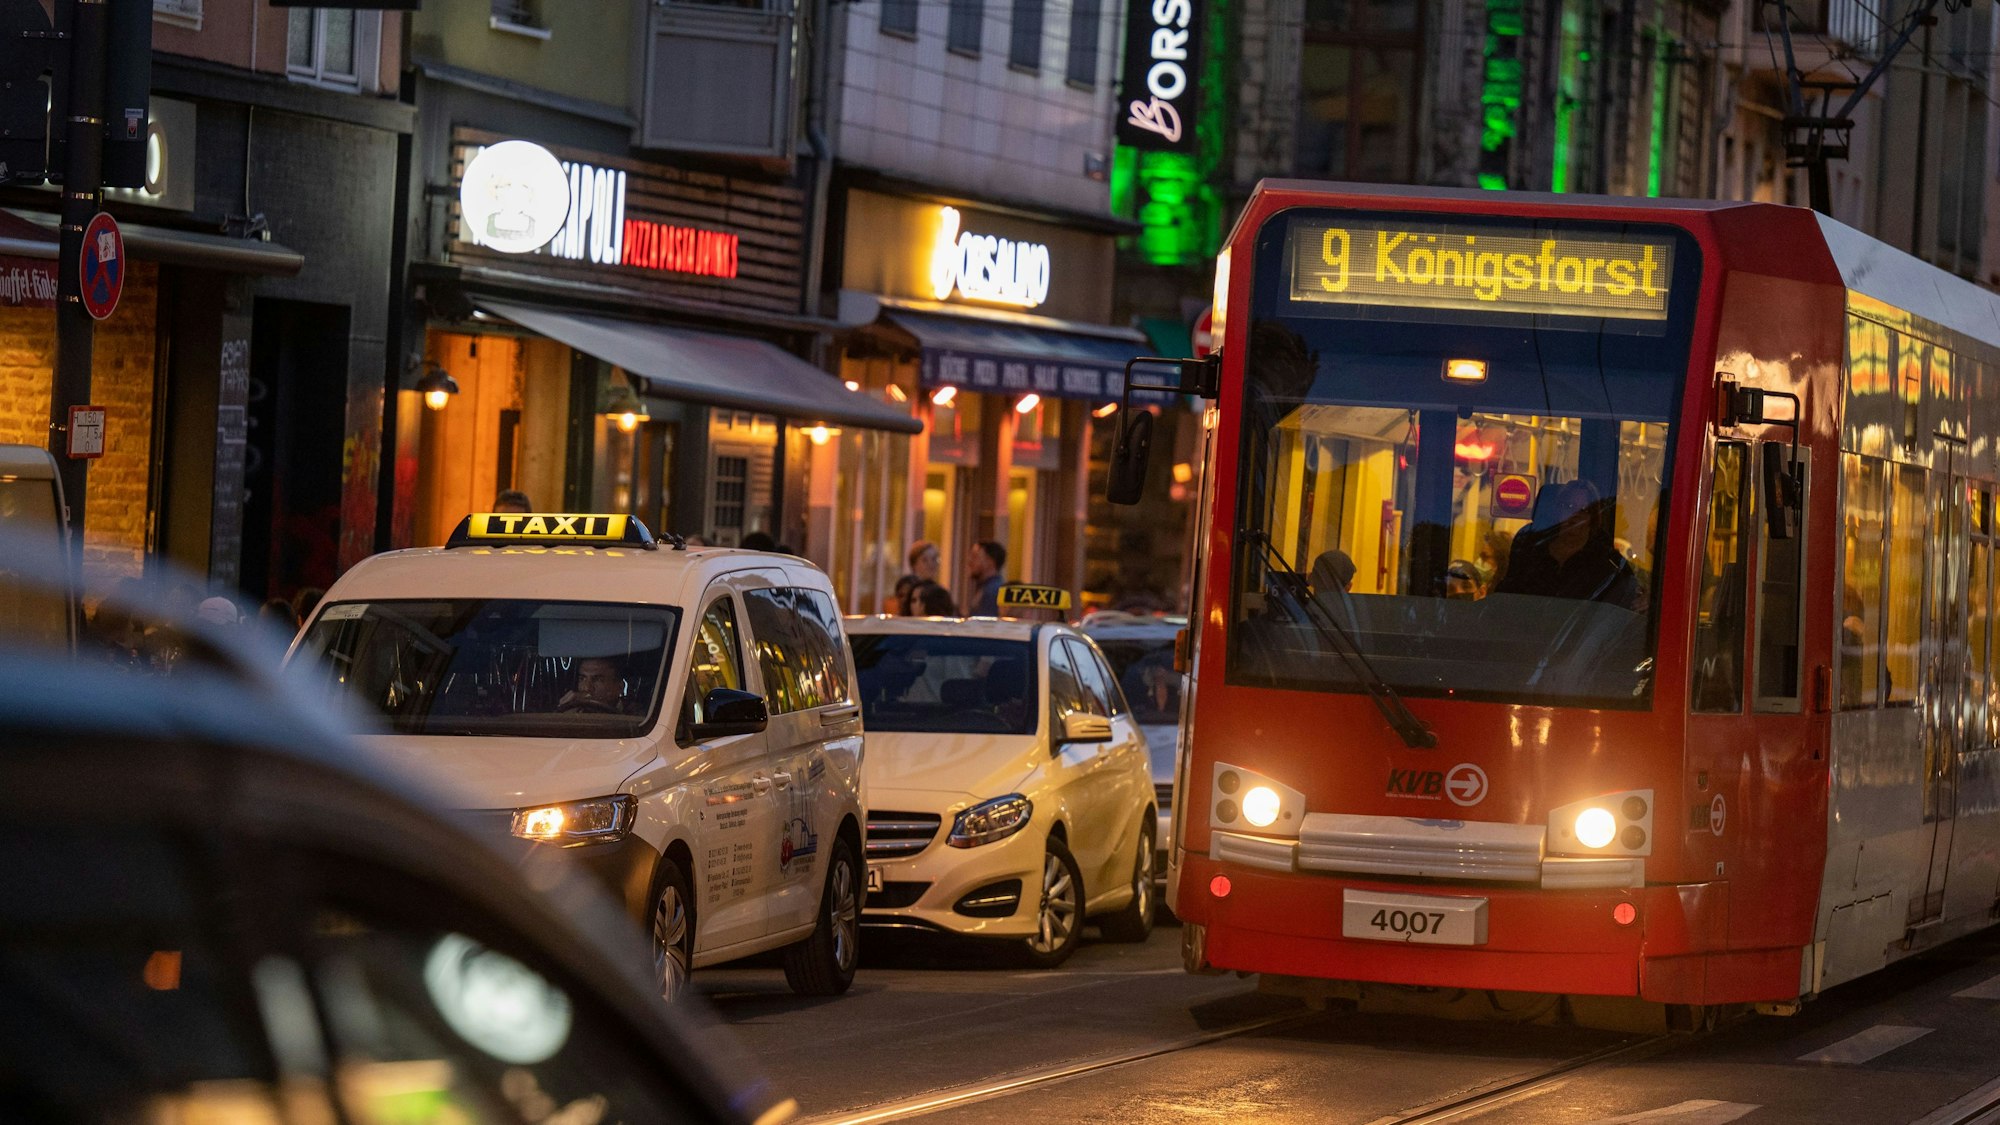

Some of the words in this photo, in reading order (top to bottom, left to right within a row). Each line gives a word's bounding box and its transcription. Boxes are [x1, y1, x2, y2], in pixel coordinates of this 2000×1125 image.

[1322, 228, 1350, 292] 9
[1376, 231, 1658, 301] Königsforst
[500, 516, 595, 535] TAXI
[1011, 588, 1057, 604] TAXI
[1386, 768, 1443, 794] KVB
[1371, 909, 1445, 934] 4007
